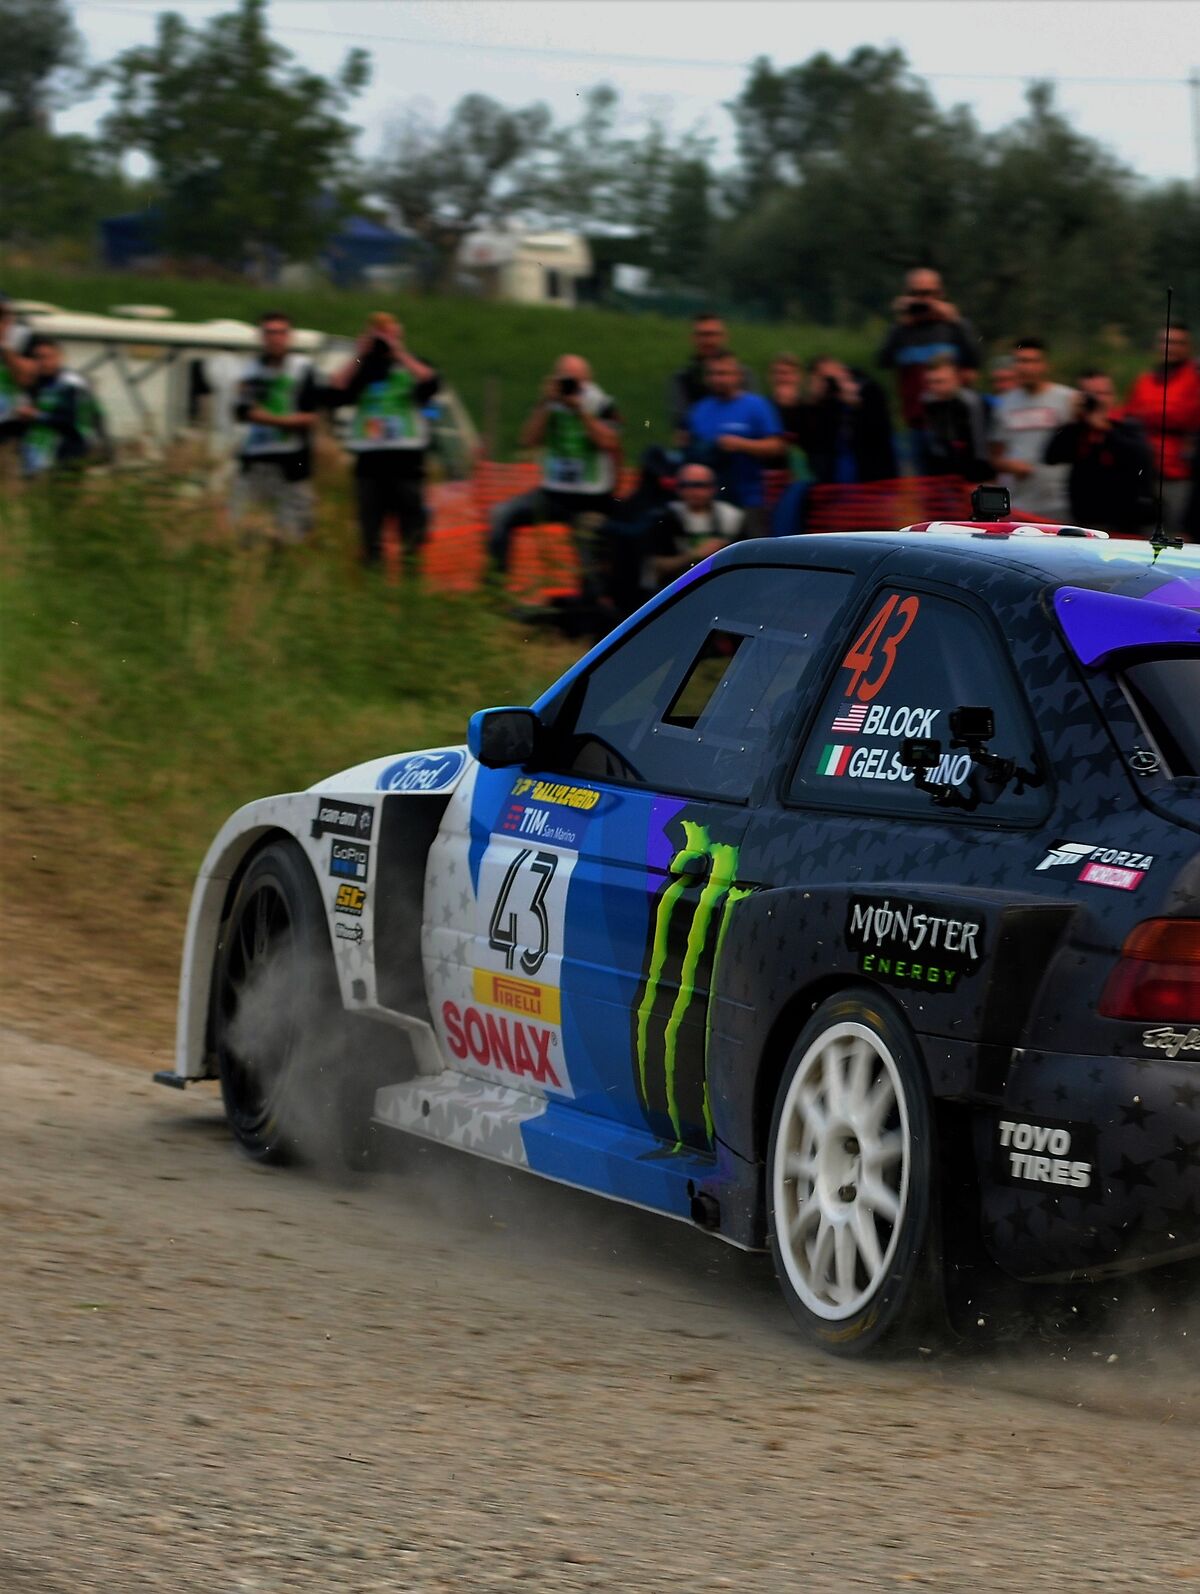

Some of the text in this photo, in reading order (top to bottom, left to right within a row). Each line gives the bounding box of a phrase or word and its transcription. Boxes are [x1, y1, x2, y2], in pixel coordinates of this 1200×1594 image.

[842, 594, 920, 701] 43
[862, 705, 941, 739] BLOCK
[388, 754, 451, 791] Ford
[848, 747, 972, 786] GELSINO
[520, 807, 576, 843] TIM San Marino
[333, 845, 367, 863] GoPro
[1089, 847, 1154, 870] FORZA
[488, 848, 559, 976] 43
[850, 901, 979, 960] MONSTER
[863, 954, 957, 985] ENERGY
[492, 976, 542, 1015] PIRELLI
[442, 1000, 562, 1089] SONAX
[999, 1120, 1072, 1156] TOYO
[1009, 1152, 1092, 1188] TIRES
